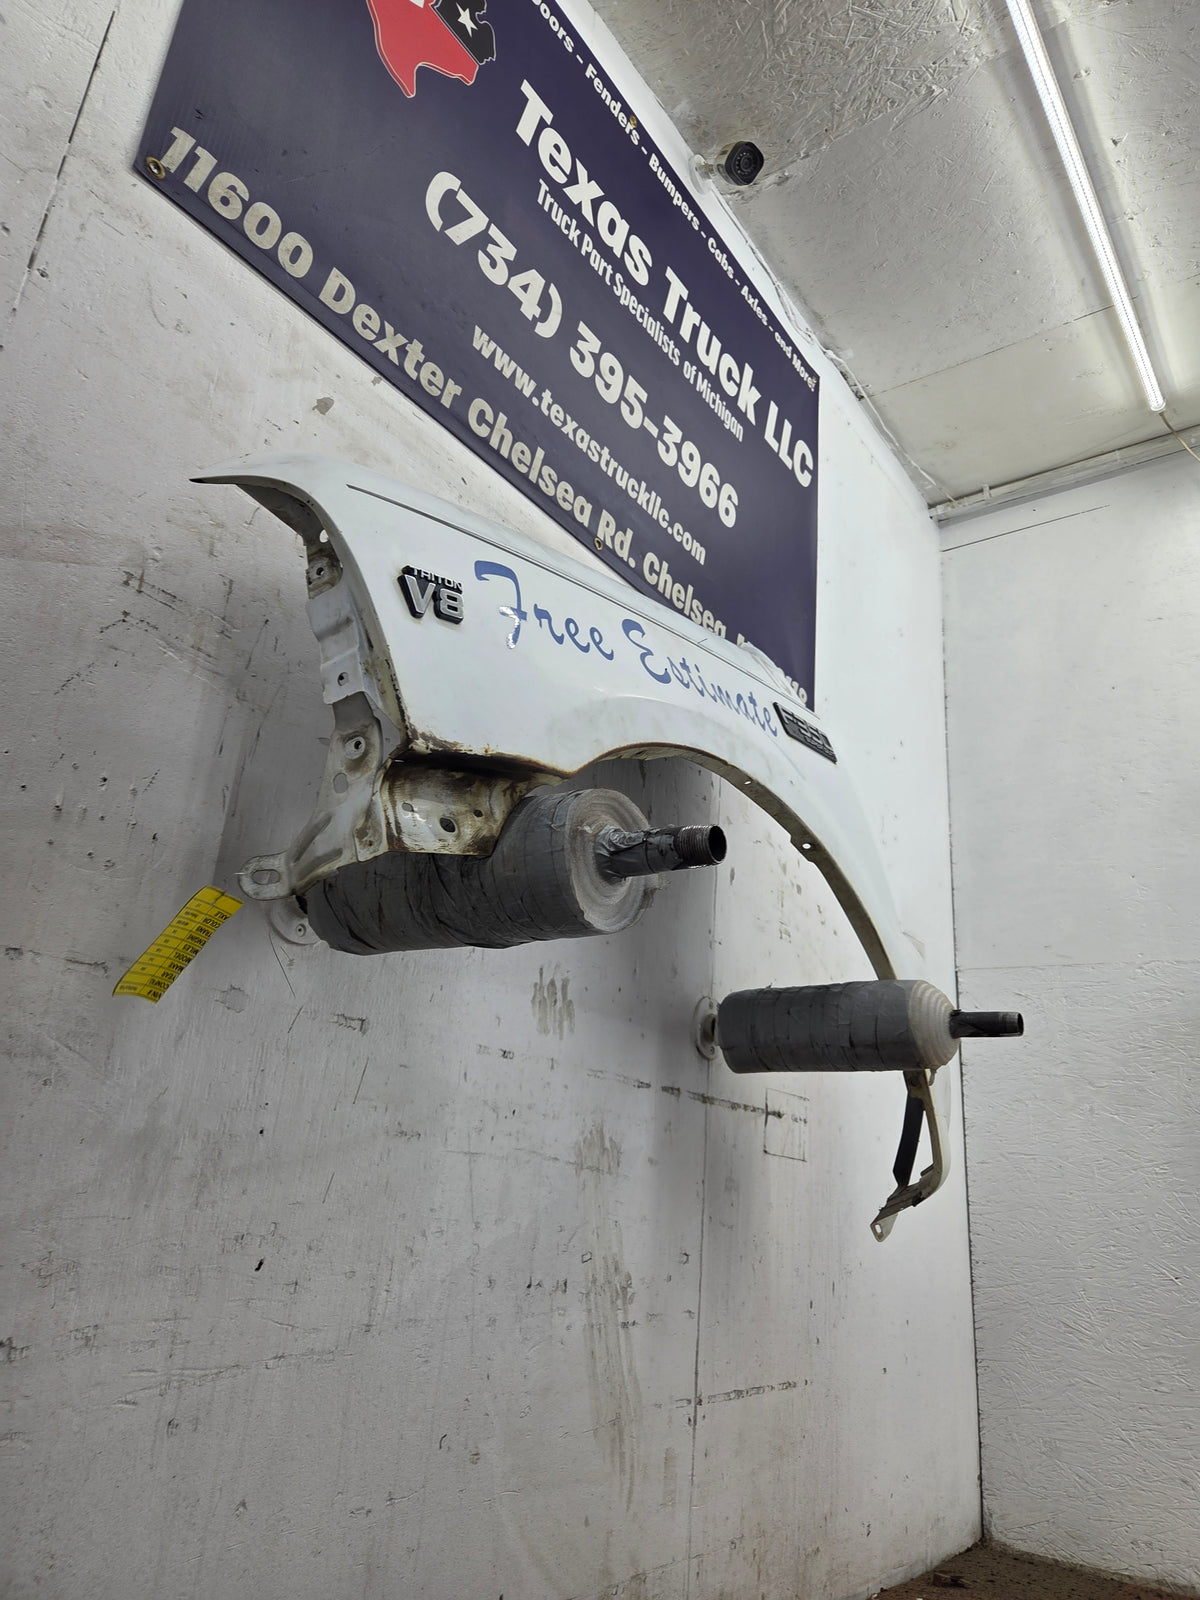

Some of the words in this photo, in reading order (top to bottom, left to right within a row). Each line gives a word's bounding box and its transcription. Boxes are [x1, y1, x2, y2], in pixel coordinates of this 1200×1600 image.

[585, 63, 640, 146] Fenders
[649, 153, 700, 231] Bumpers
[707, 237, 734, 281] Cabs
[741, 285, 768, 326] Axles
[775, 332, 792, 359] and
[516, 79, 652, 286] Texas
[663, 266, 761, 425] Truck
[764, 401, 814, 488] LLC
[537, 179, 581, 247] Truck
[581, 234, 615, 287] Part
[613, 273, 681, 366] Specialists
[683, 360, 698, 384] of
[696, 371, 744, 442] Michigan
[160, 126, 313, 278] 11600
[318, 267, 462, 408] Dexter
[468, 398, 592, 527] Chelsea
[597, 509, 636, 569] Rd.
[425, 171, 563, 338] (734)
[569, 321, 738, 528] 395-3966
[472, 325, 706, 566] www.texastruckllc.com
[400, 574, 464, 622] V8
[409, 565, 463, 590] TRITON
[474, 560, 614, 661] Free
[622, 618, 777, 737] Estimate
[187, 933, 207, 946] ENGINE
[202, 917, 221, 929] COLOR
[214, 911, 230, 921] AXLE
[173, 951, 192, 964] MODEL
[182, 943, 200, 955] MILES
[161, 971, 176, 981] YEAR
